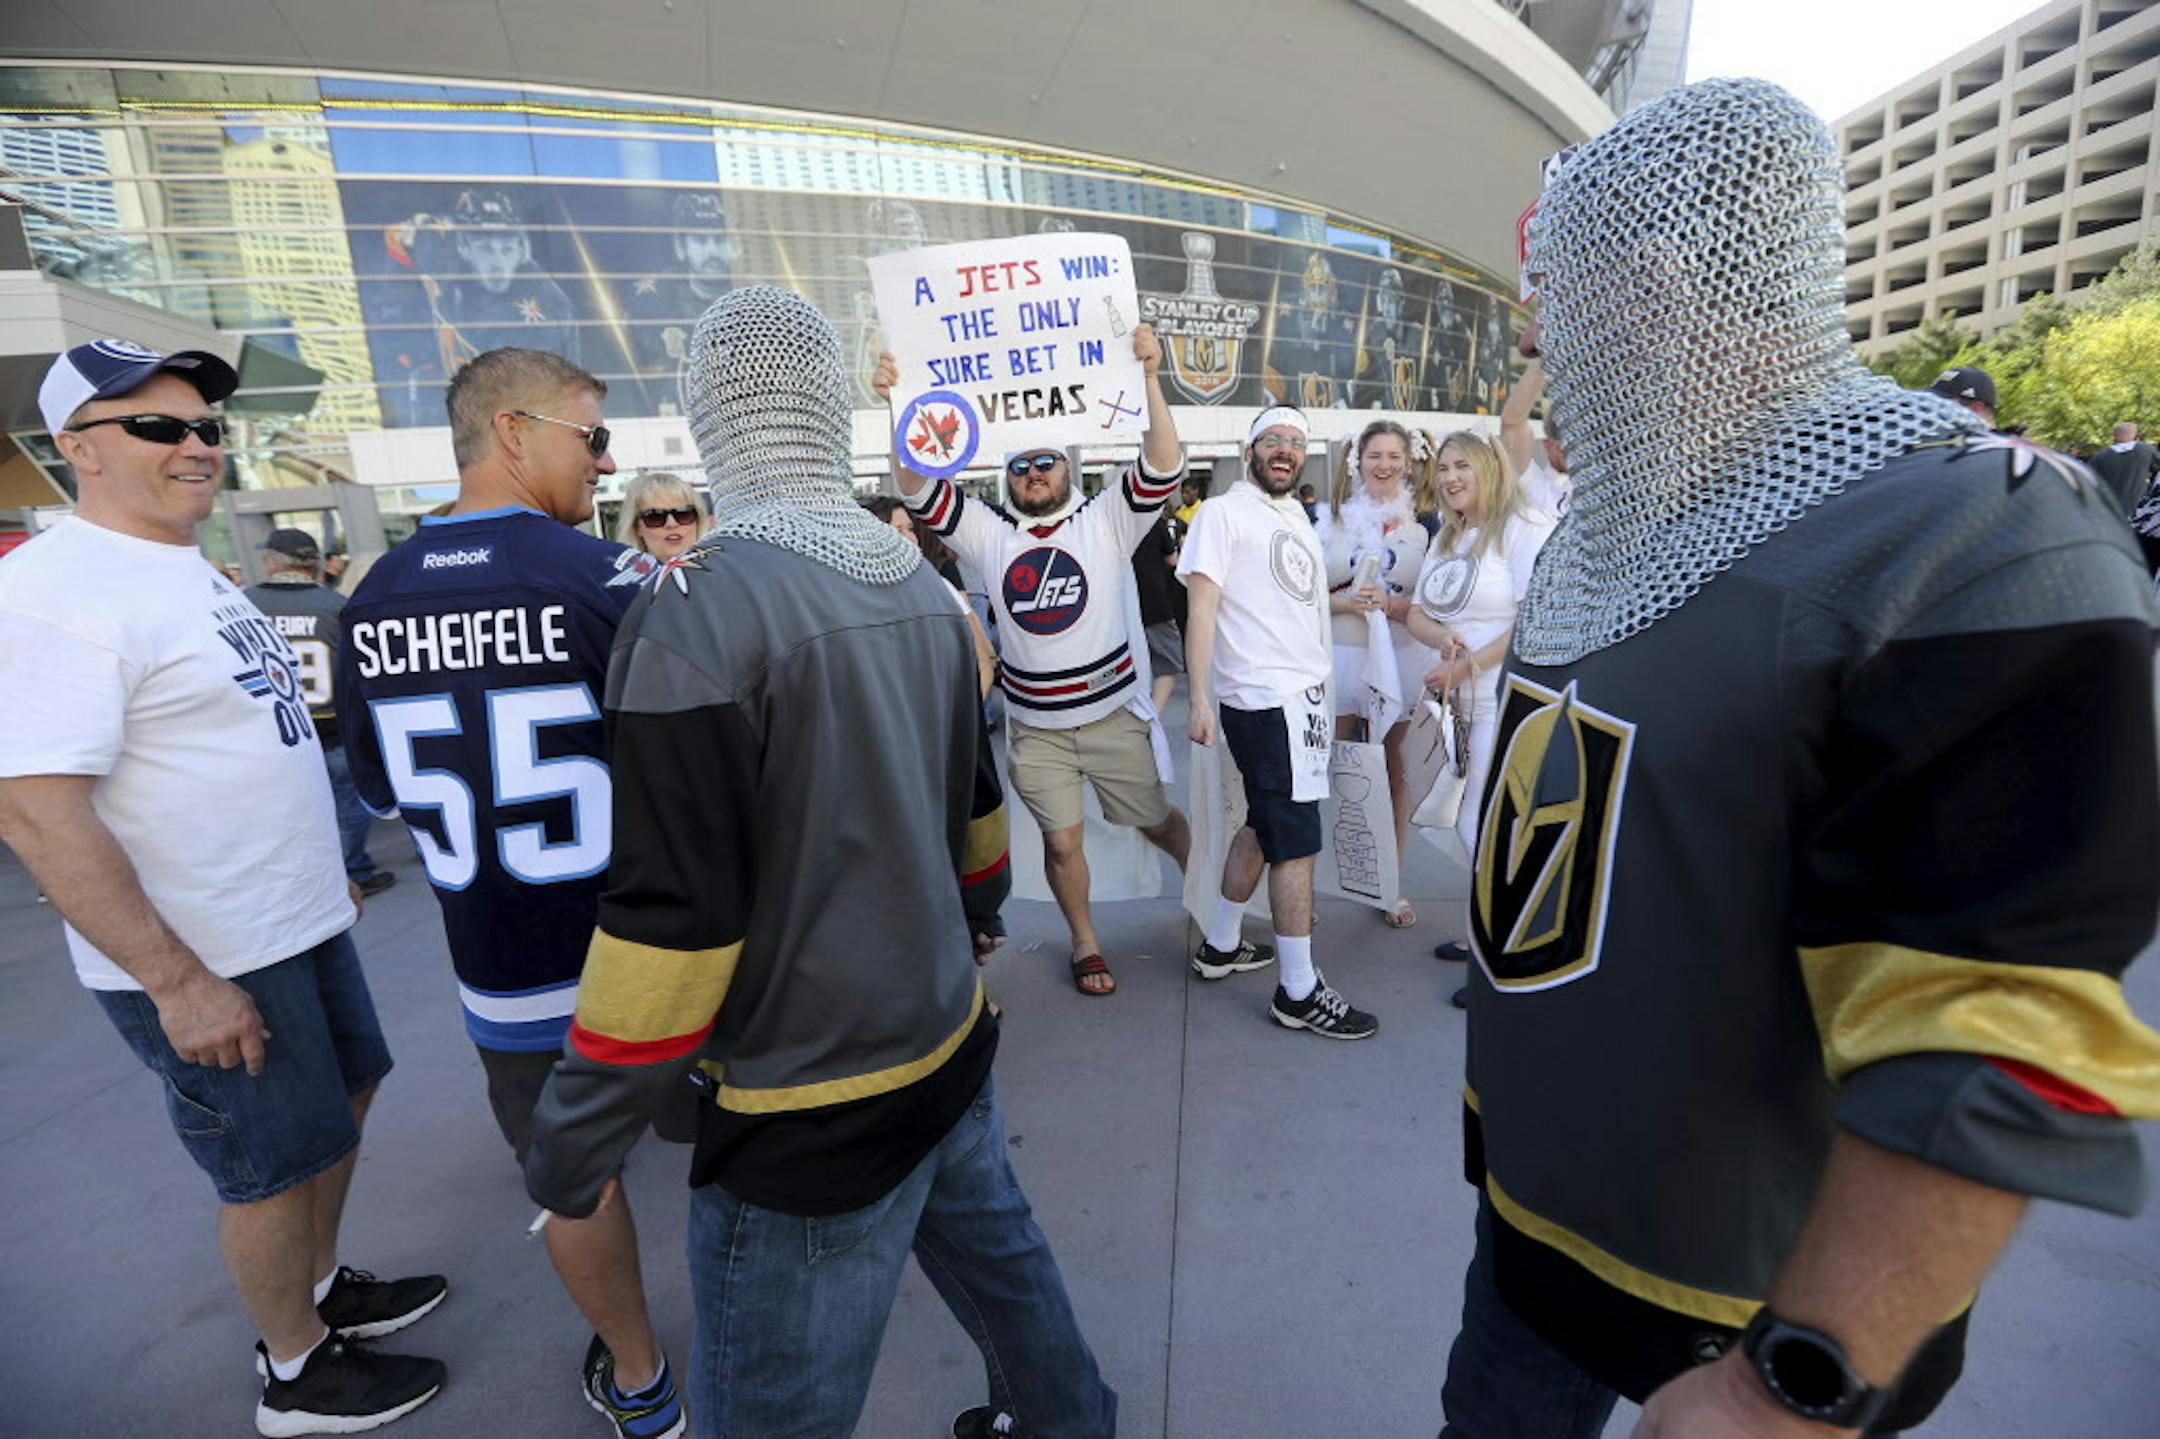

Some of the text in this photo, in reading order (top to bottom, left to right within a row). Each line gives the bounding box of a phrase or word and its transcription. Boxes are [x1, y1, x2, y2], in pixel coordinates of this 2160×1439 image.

[915, 255, 1119, 306] A JETS WIN:
[941, 298, 1080, 342] THE ONLY
[1142, 298, 1221, 320] STANLEY
[1157, 319, 1248, 338] PLAYOFFS
[927, 340, 1104, 387] SURE BET IN
[977, 384, 1087, 423] VEGAS
[423, 548, 491, 569] Reebok
[1011, 549, 1082, 613] JETS
[352, 605, 570, 679] SCHEIFELE
[367, 681, 613, 892] 55
